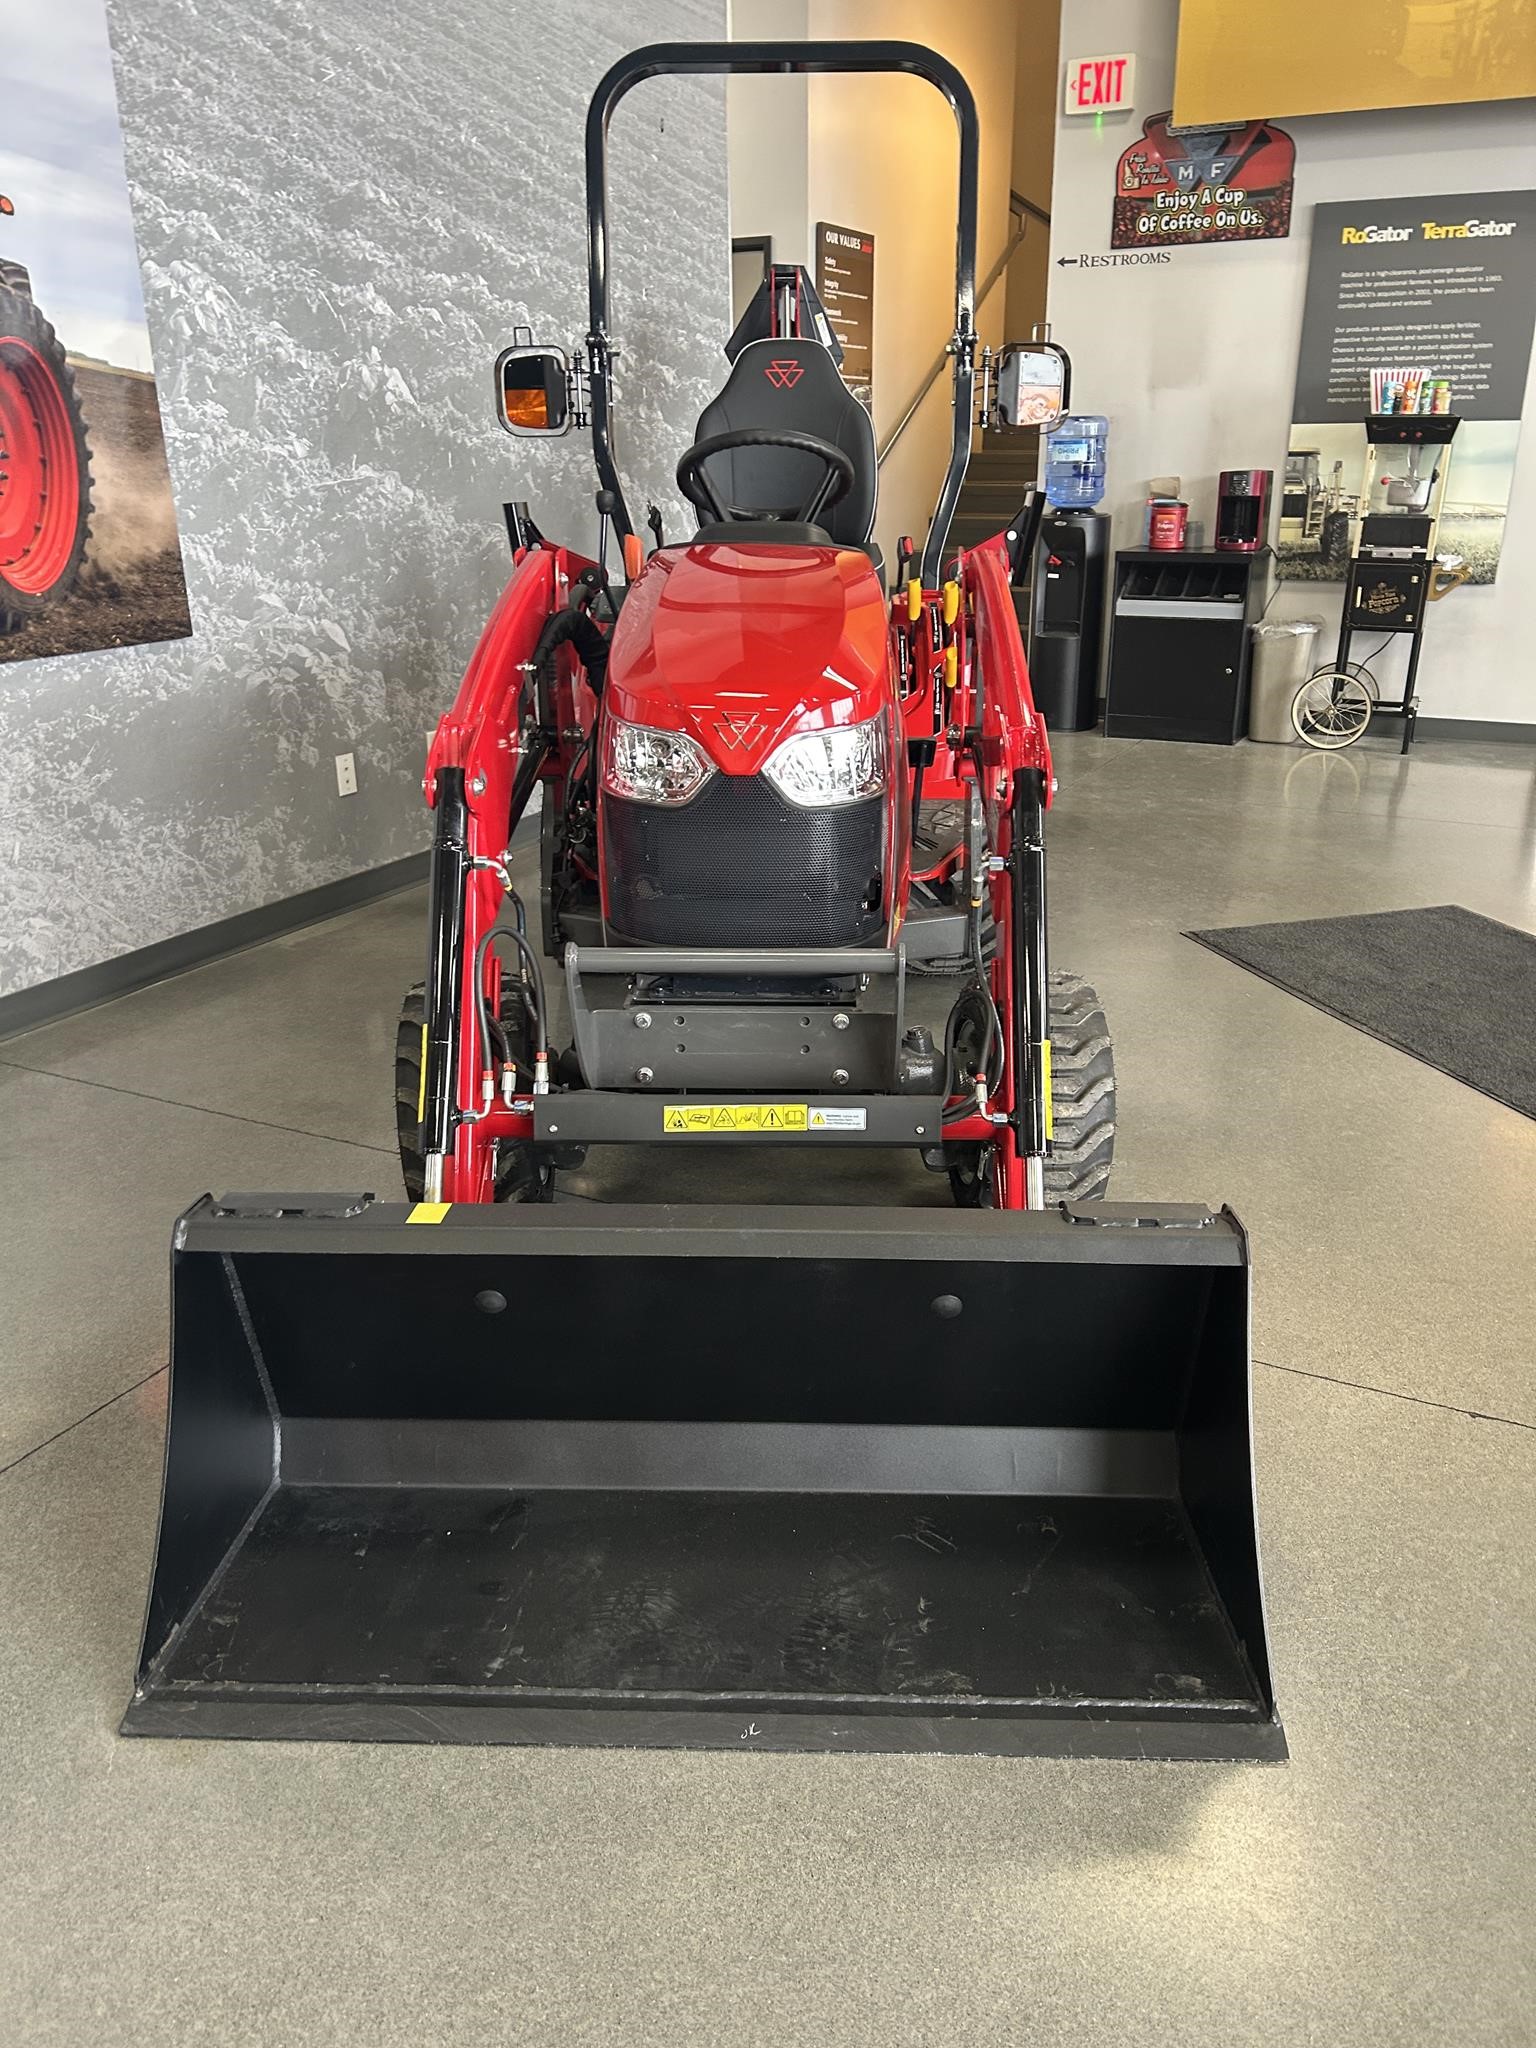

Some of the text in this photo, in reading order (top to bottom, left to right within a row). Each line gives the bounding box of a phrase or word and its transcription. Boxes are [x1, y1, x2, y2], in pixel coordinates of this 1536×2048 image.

[1078, 59, 1126, 106] EXIT
[1178, 163, 1225, 180] M F
[1156, 187, 1244, 210] Enjoy A Cup
[1139, 209, 1263, 232] Of Coffee On Us.
[826, 231, 860, 250] OUR VALUES
[1341, 220, 1516, 245] RoGator TerraGator
